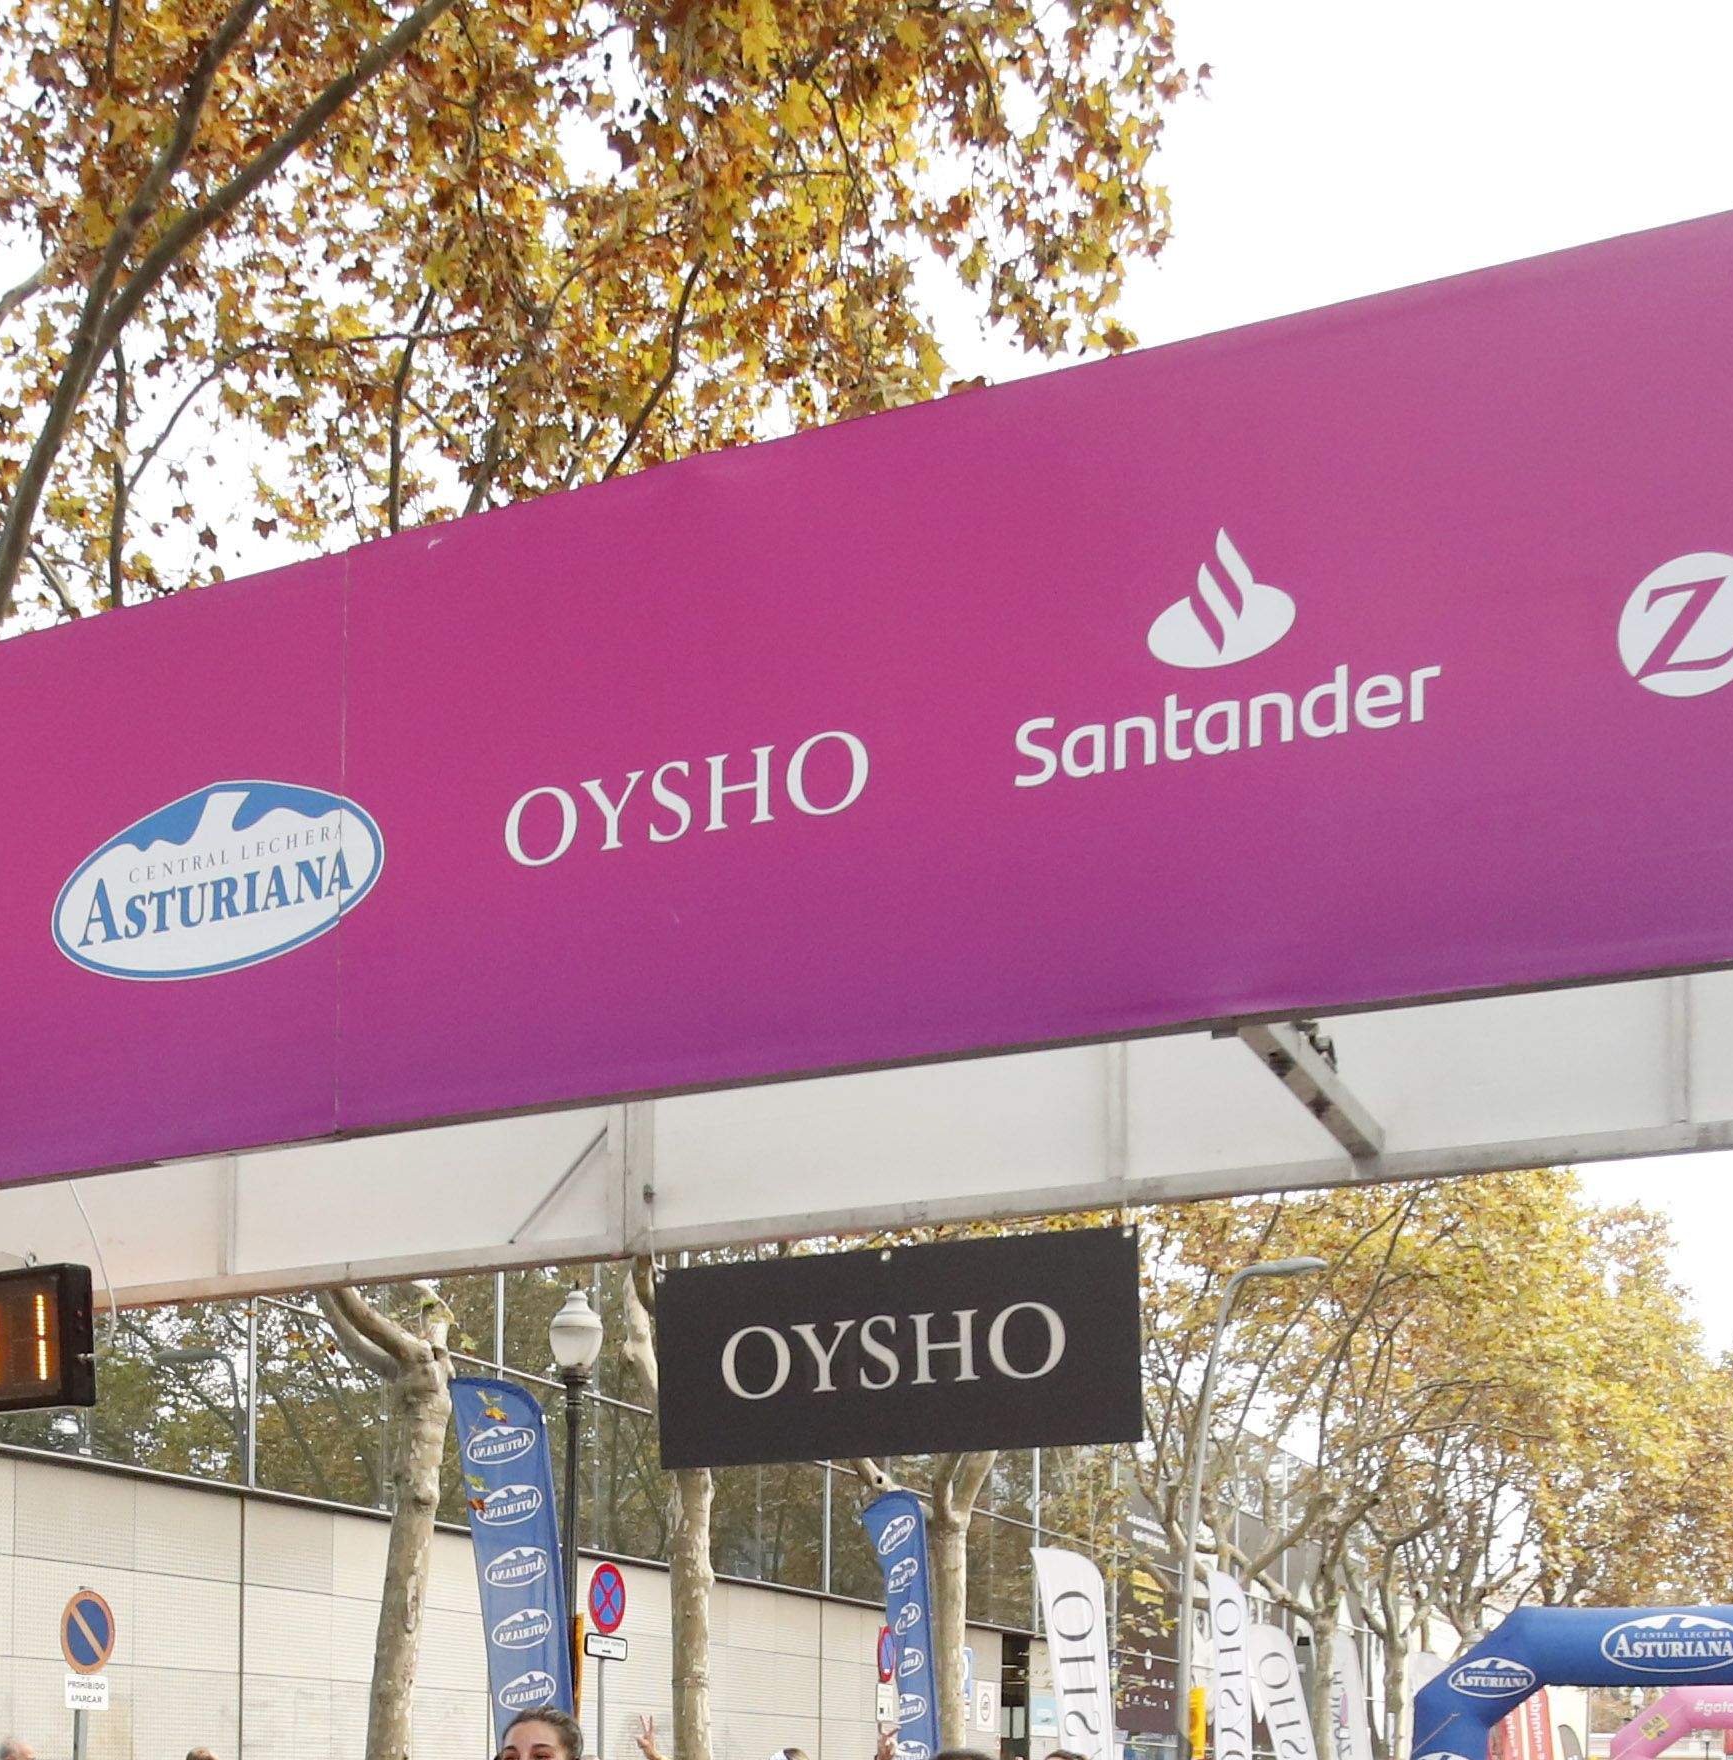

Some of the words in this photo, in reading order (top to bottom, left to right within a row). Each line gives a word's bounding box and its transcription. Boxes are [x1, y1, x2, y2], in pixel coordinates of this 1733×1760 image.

[1014, 663, 1442, 788] Santander
[503, 731, 869, 867] OYSHO
[78, 847, 355, 947] ASTURIANA
[128, 848, 230, 884] CENTRAL
[240, 822, 346, 861] LECHERA
[720, 1300, 1067, 1400] OYSHO
[1455, 1672, 1529, 1688] ASTURIANA
